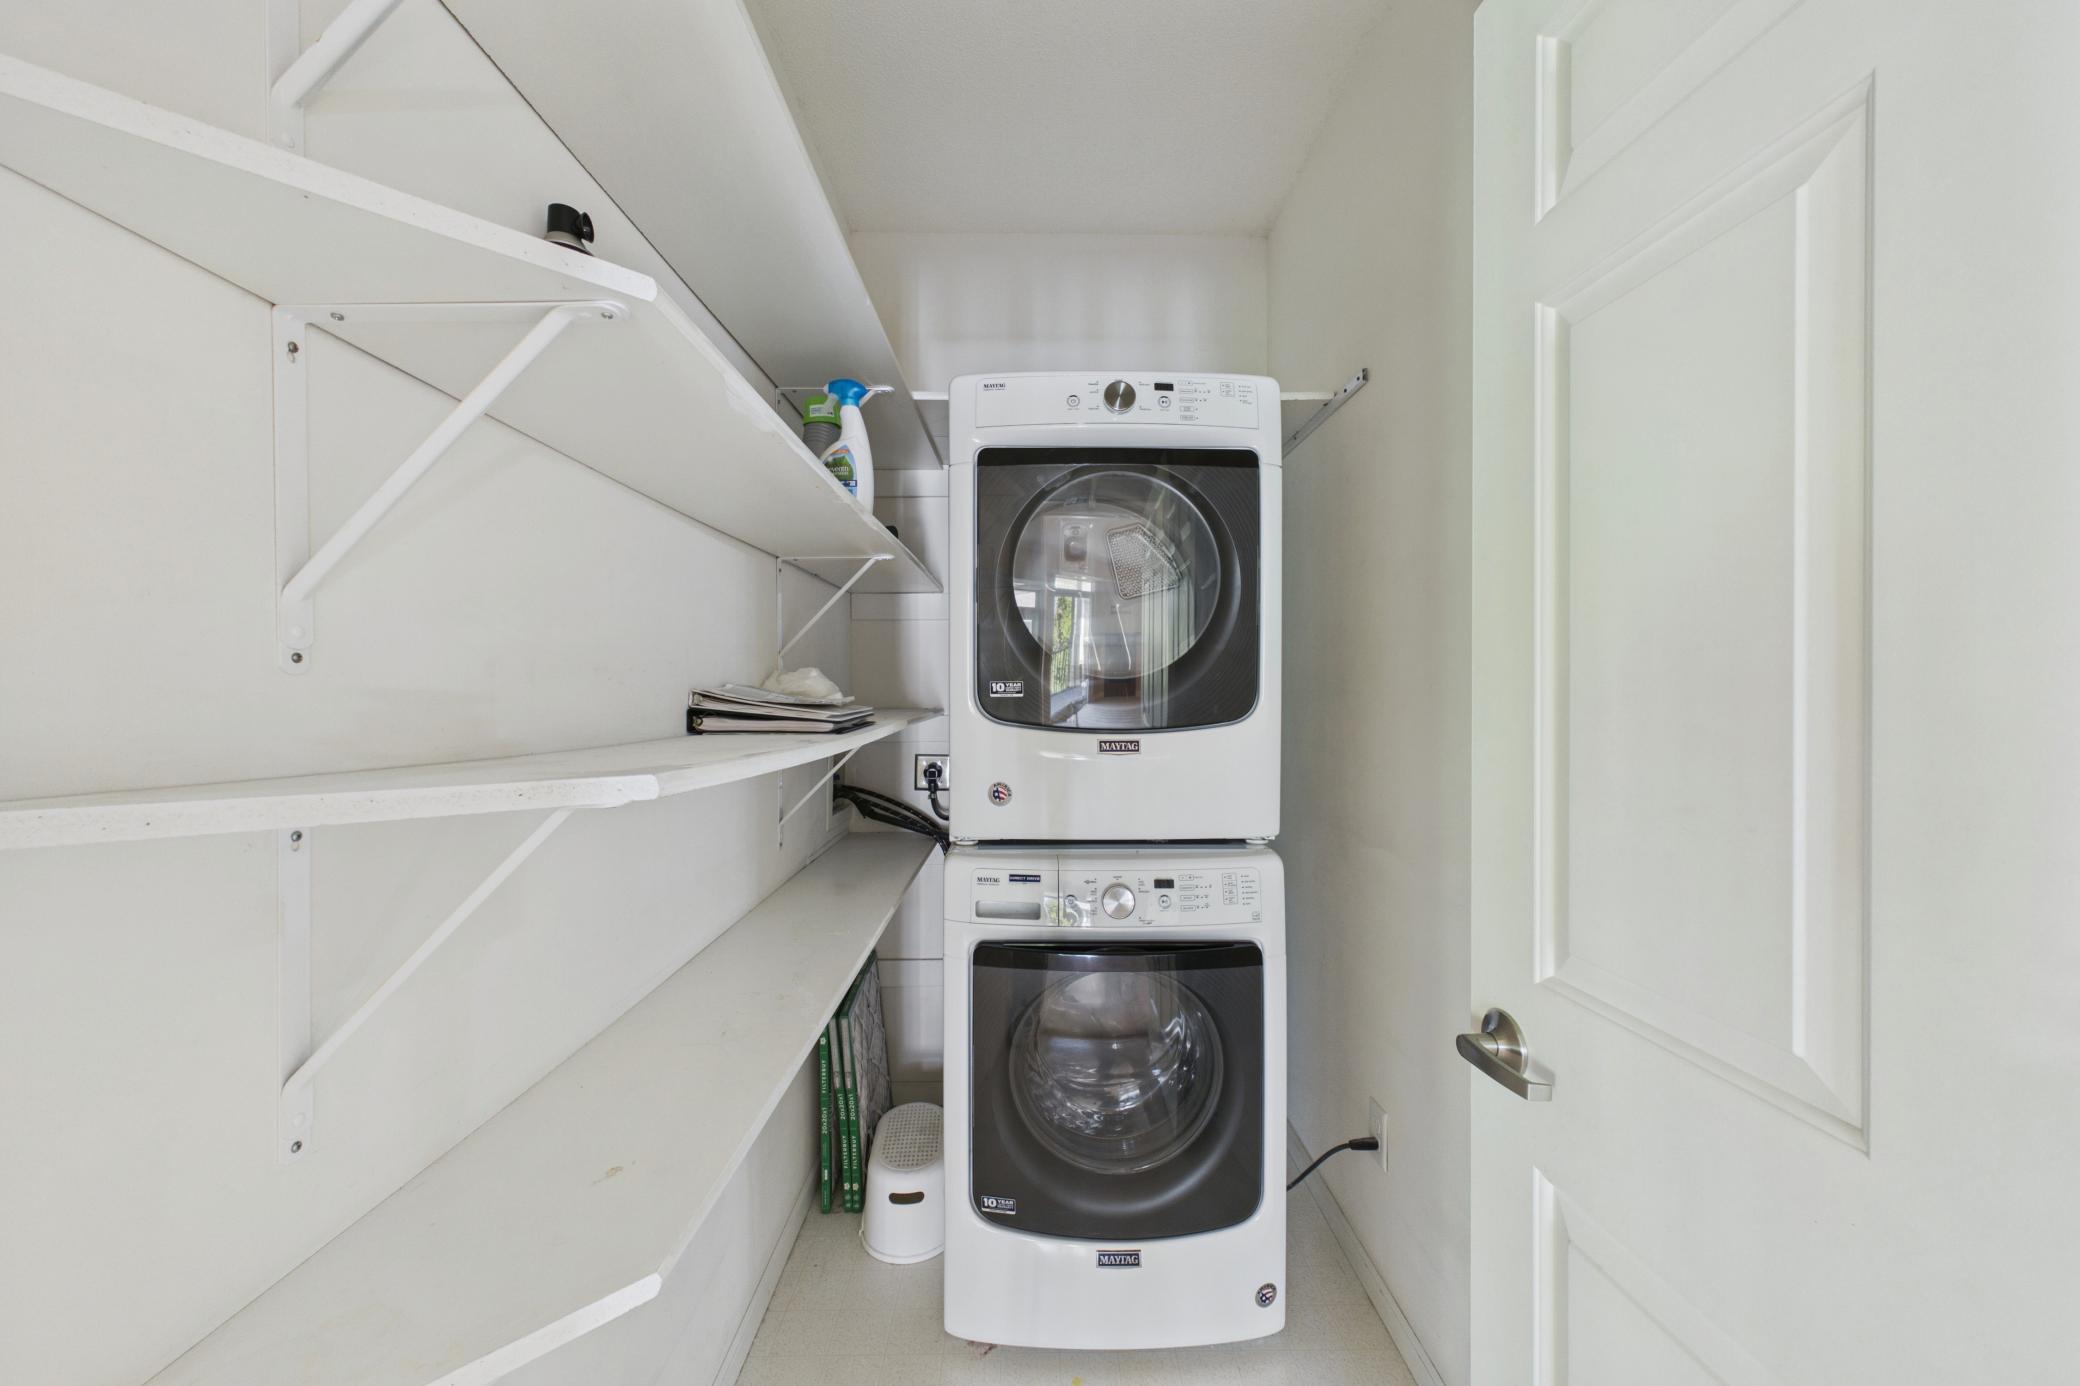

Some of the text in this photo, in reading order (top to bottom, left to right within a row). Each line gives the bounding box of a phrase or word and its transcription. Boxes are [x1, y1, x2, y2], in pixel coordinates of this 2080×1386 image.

[991, 682, 1005, 692] 10
[1100, 742, 1138, 750] MAYTAG
[838, 1093, 846, 1120] 20x20x1
[848, 1093, 856, 1120] 20x20x1
[983, 1197, 997, 1208] 10
[1099, 1255, 1139, 1265] MAYTAG
